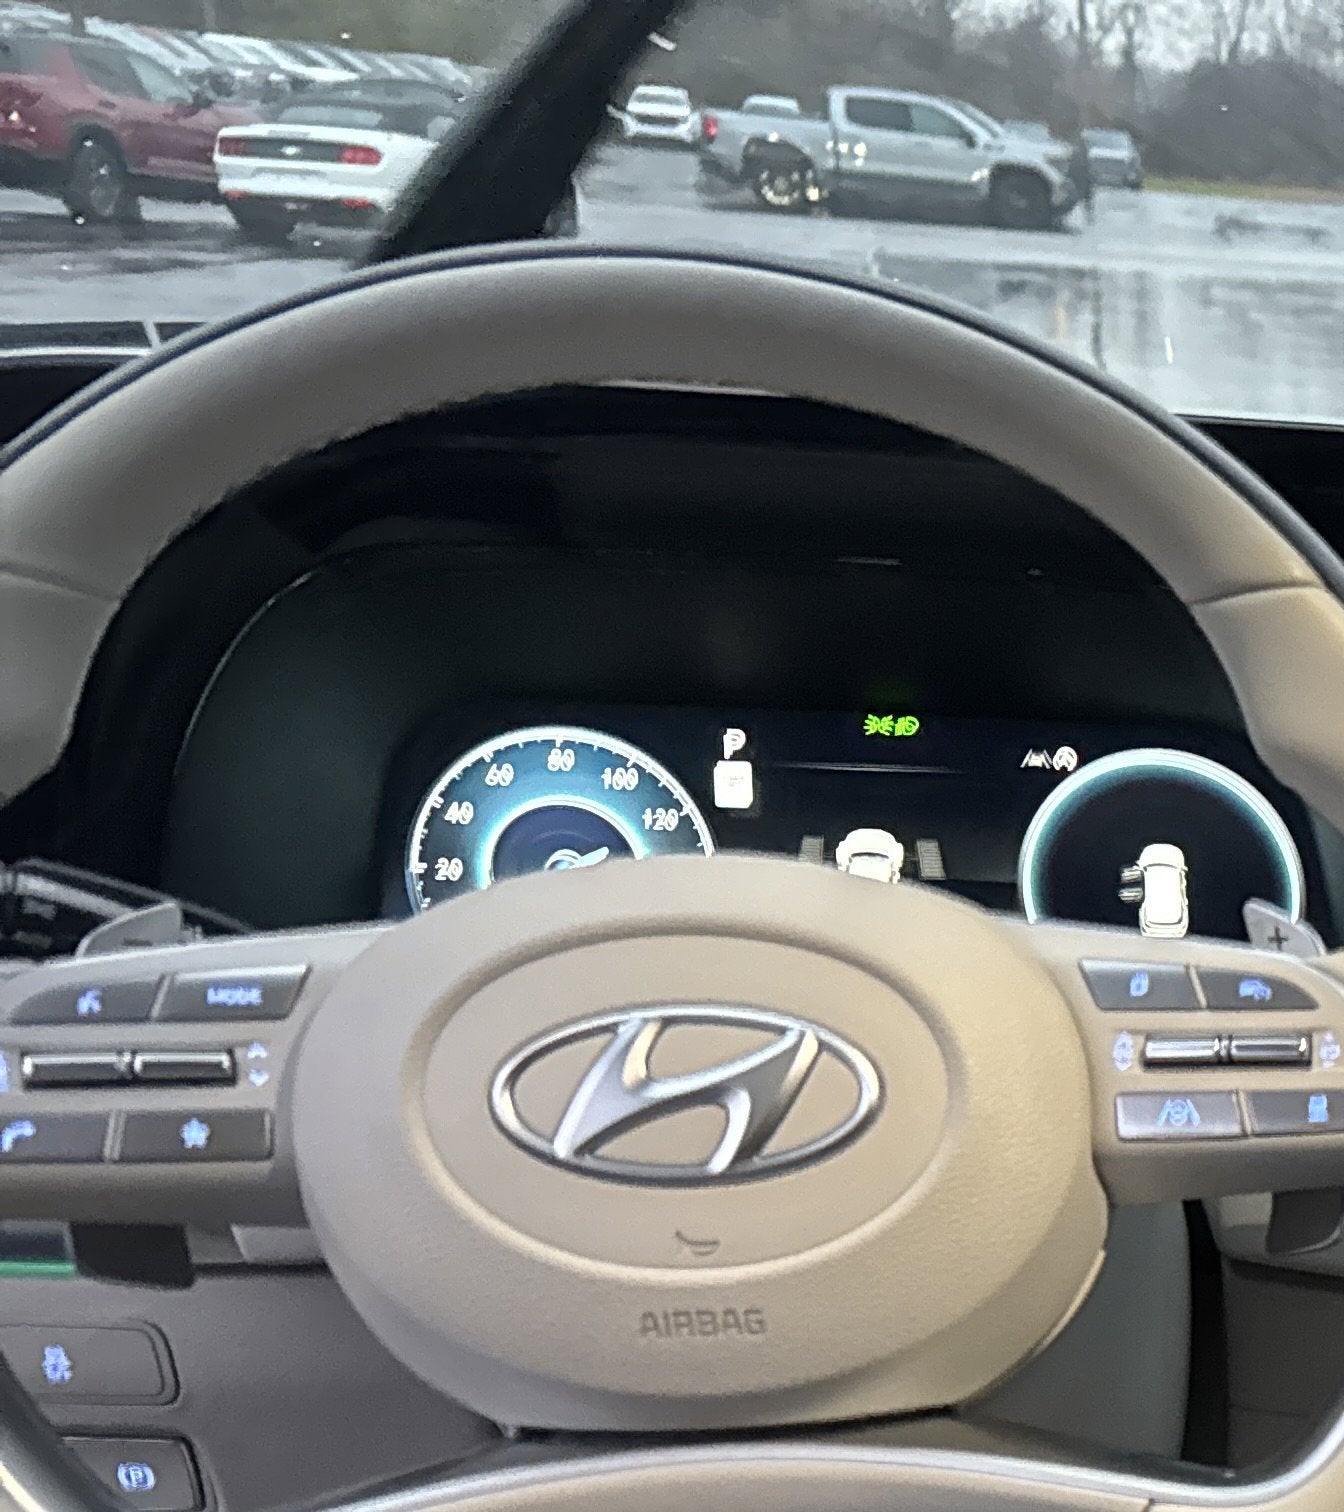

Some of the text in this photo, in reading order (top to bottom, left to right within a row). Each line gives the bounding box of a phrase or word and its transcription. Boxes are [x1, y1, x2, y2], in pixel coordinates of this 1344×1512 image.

[723, 728, 746, 760] P
[548, 748, 575, 772] 80
[484, 763, 515, 787] 60
[601, 767, 639, 791] 100
[444, 801, 474, 825] 40
[642, 808, 680, 832] 120
[434, 858, 464, 882] 20
[638, 1308, 768, 1339] AIRBAG
